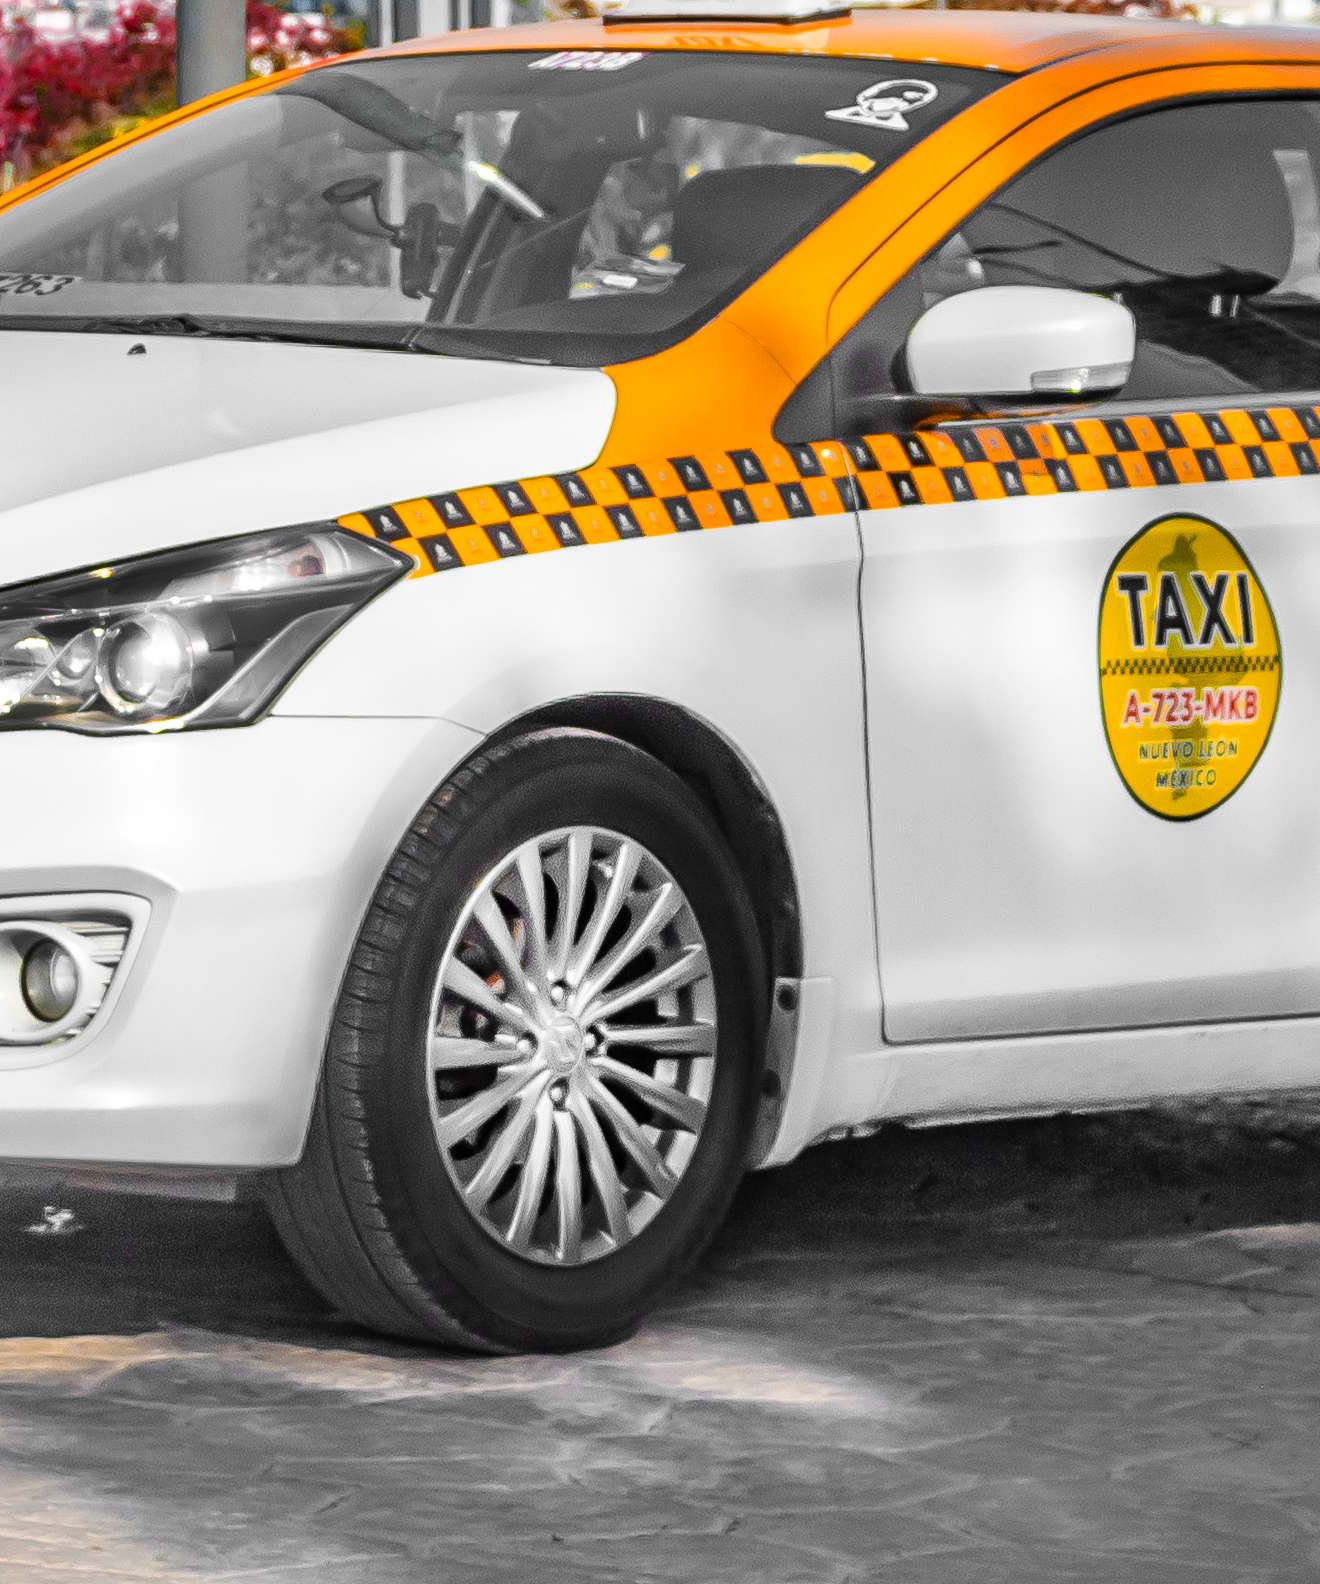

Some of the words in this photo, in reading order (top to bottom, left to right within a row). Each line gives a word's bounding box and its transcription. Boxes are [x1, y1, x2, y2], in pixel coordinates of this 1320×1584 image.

[1117, 574, 1255, 647] TAXI
[1122, 689, 1258, 725] A-723-MKB
[1139, 742, 1194, 760] NUEVO
